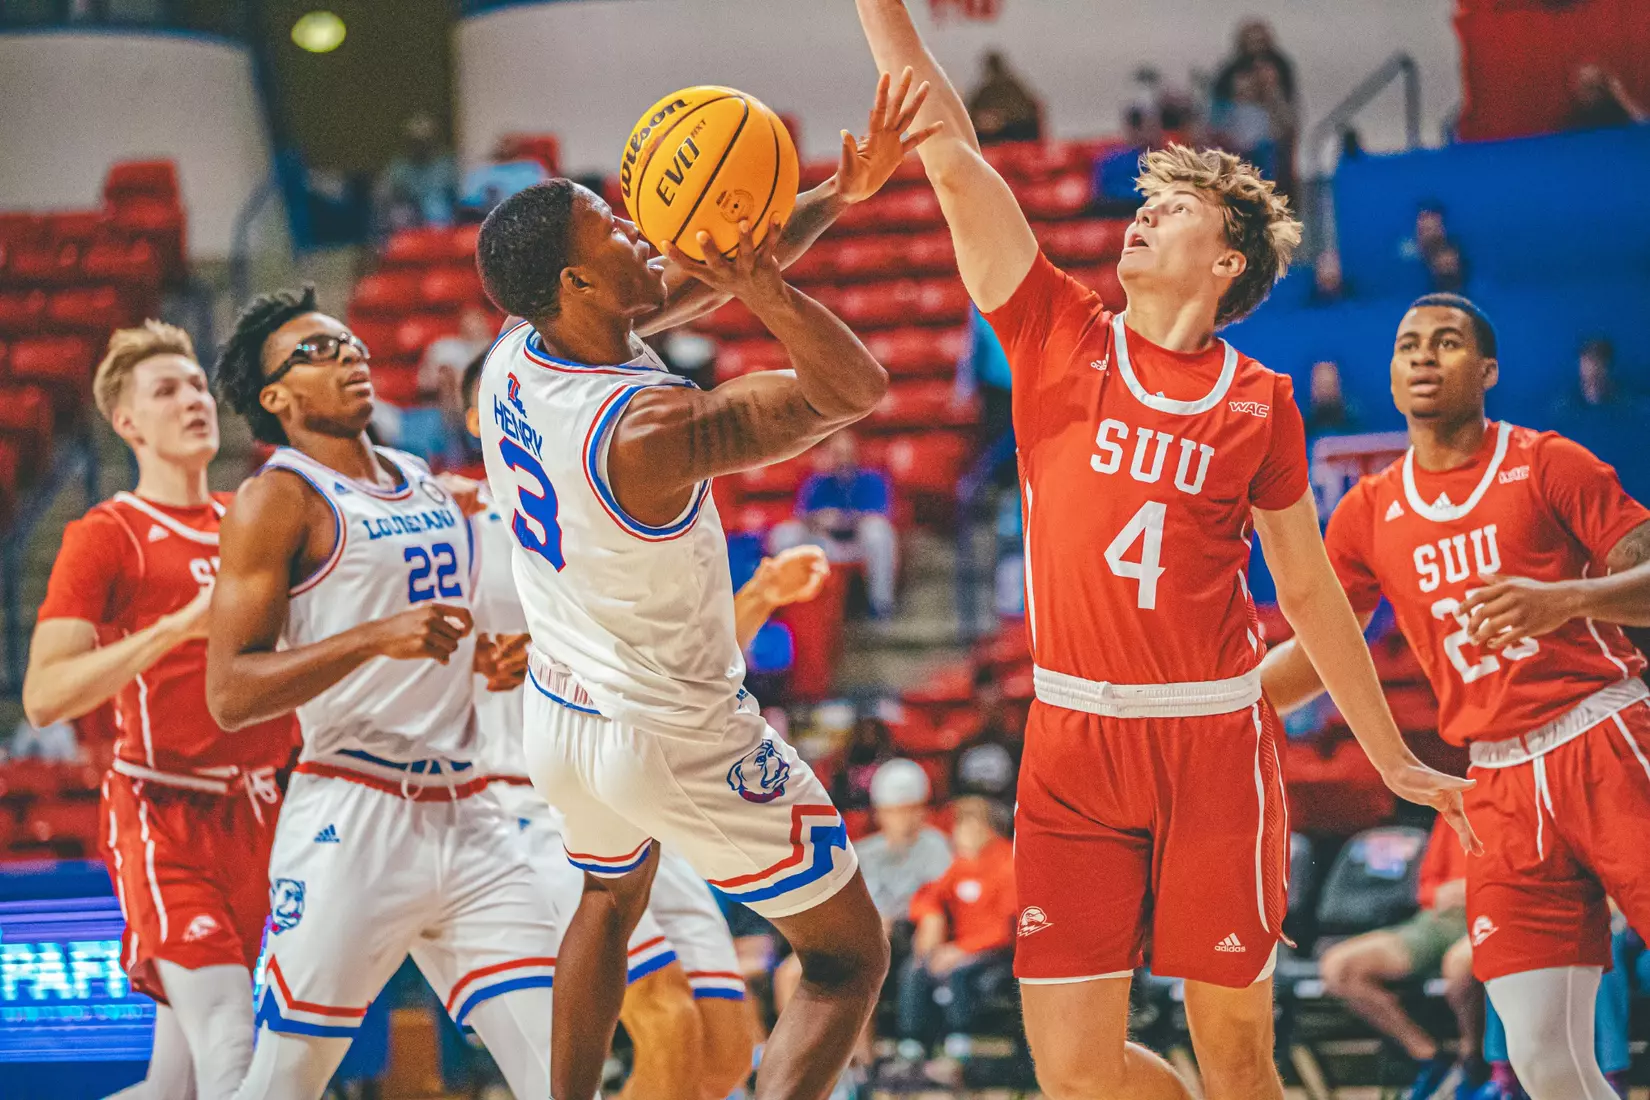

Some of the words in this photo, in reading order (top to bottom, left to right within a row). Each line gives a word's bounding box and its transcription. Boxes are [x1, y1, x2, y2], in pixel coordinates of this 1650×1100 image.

[493, 394, 543, 461] HENRY
[1229, 401, 1269, 417] WAC
[1090, 418, 1215, 495] SUU
[499, 436, 566, 573] 3
[404, 543, 463, 604] 22
[1104, 500, 1167, 610] 4
[1413, 524, 1501, 593] SUU
